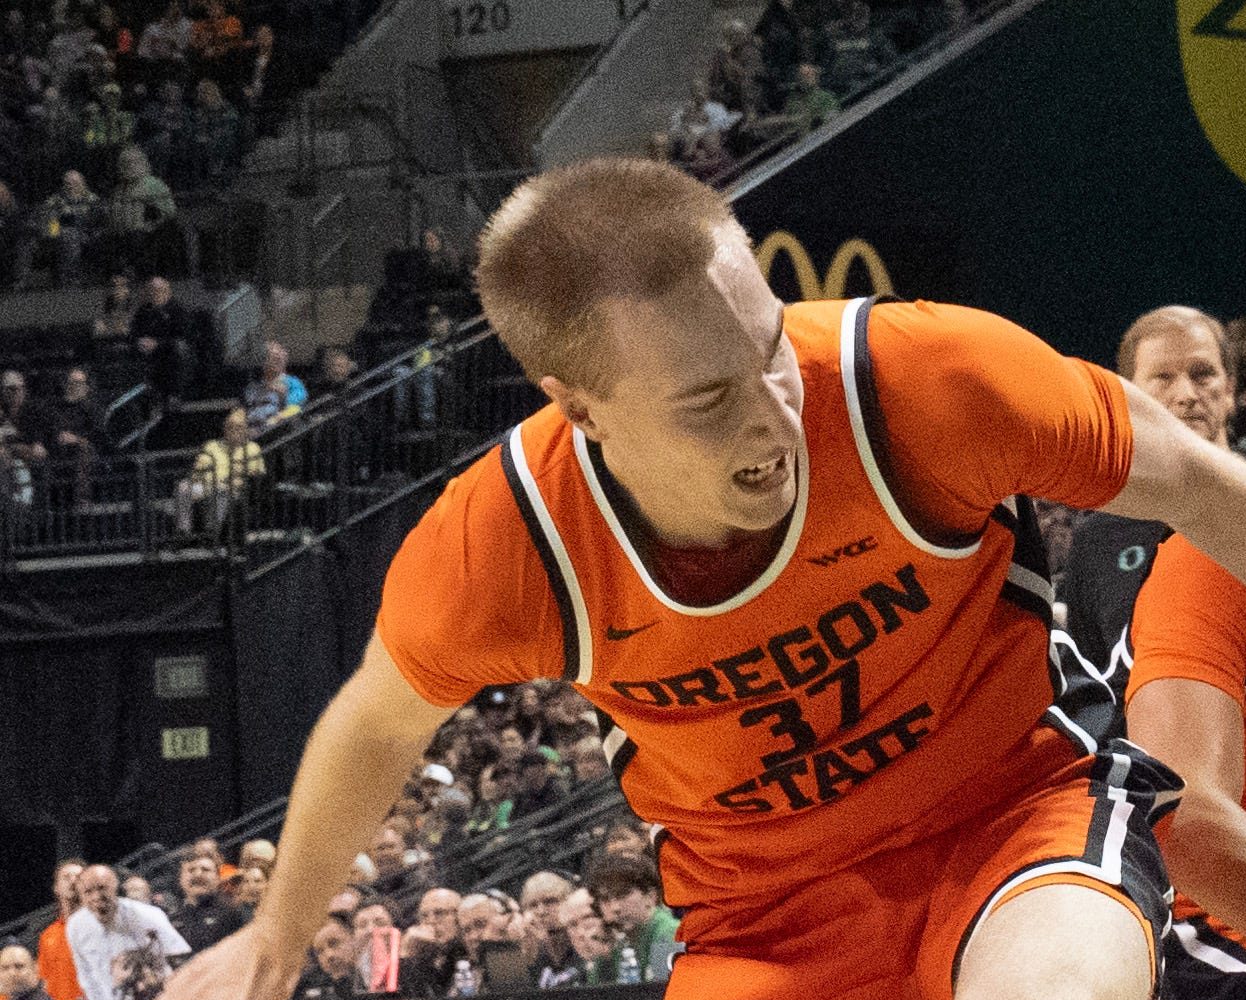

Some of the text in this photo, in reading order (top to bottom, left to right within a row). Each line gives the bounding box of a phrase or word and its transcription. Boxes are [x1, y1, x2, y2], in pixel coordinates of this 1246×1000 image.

[450, 2, 510, 37] 120
[610, 562, 932, 708] OREGON
[739, 657, 862, 772] 37
